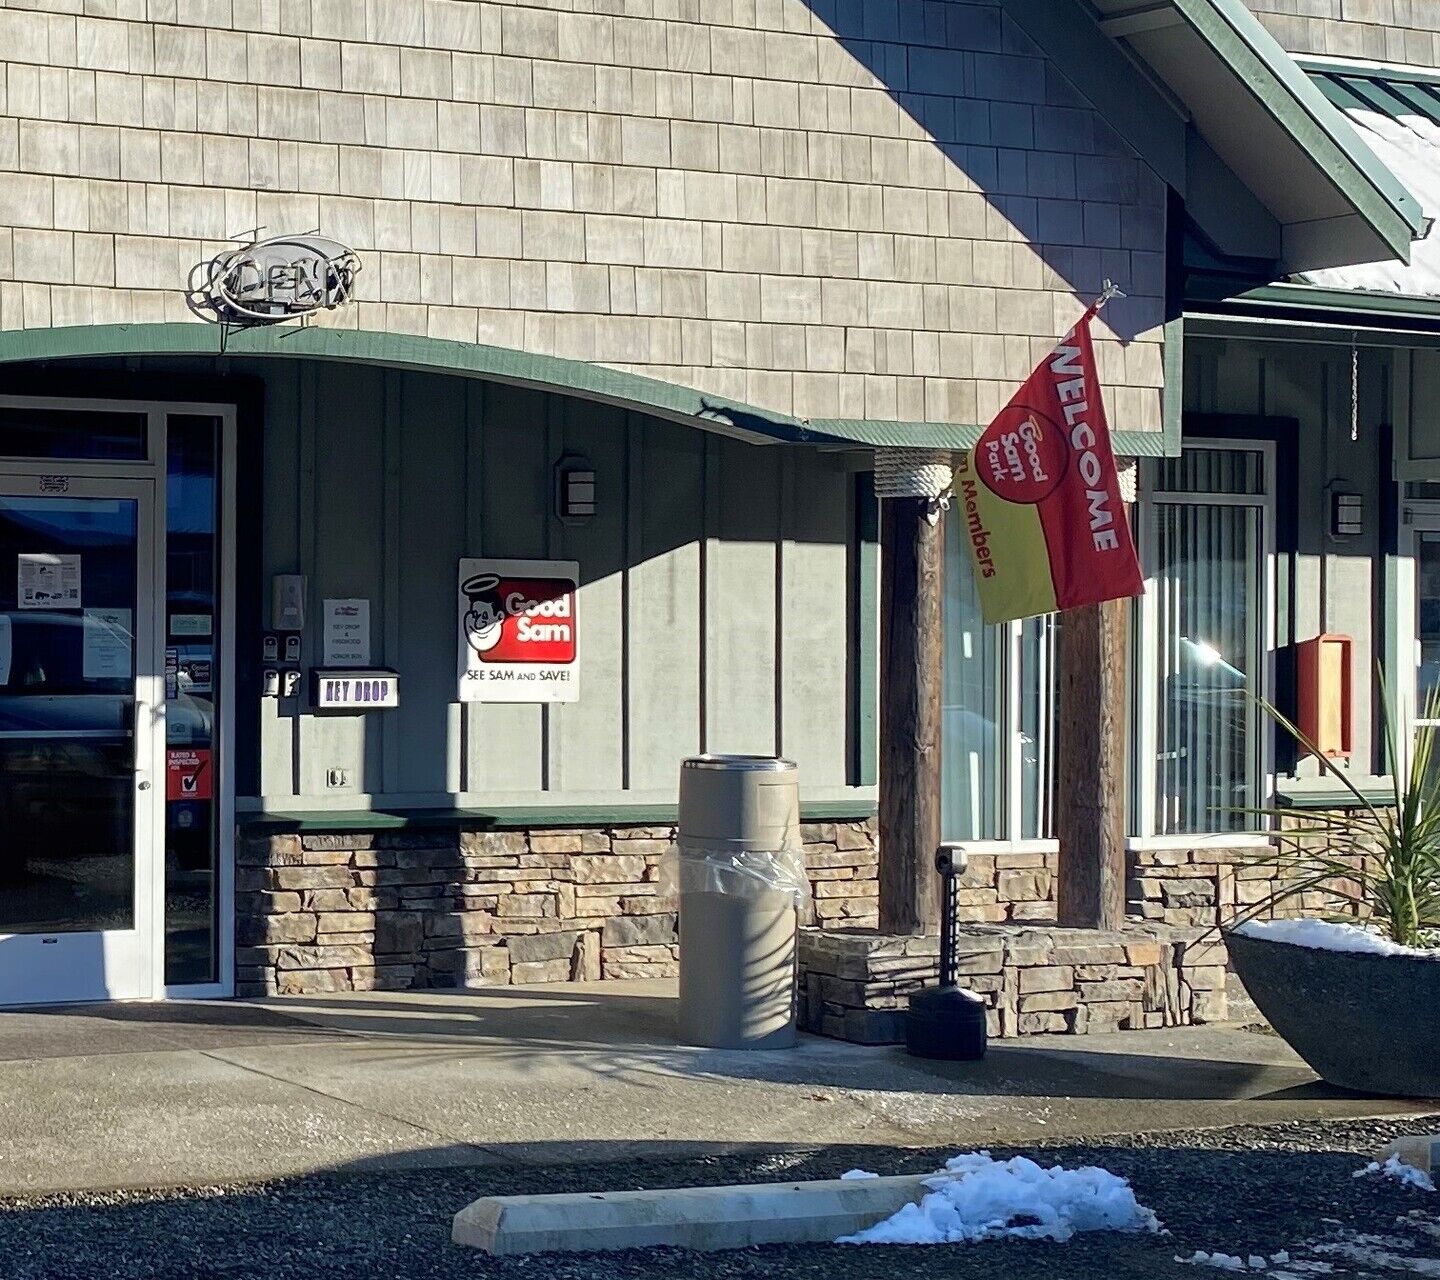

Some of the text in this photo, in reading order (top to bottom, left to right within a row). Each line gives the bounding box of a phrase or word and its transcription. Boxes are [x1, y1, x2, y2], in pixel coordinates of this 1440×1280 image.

[985, 440, 1006, 483] Park
[1001, 432, 1025, 482] Sam
[1017, 421, 1049, 483] Good
[961, 479, 996, 579] Members
[504, 591, 571, 618] Good
[516, 616, 571, 642] Sam
[326, 681, 388, 702] KEY DROP
[467, 669, 571, 682] SEE SAM AND SAVE!
